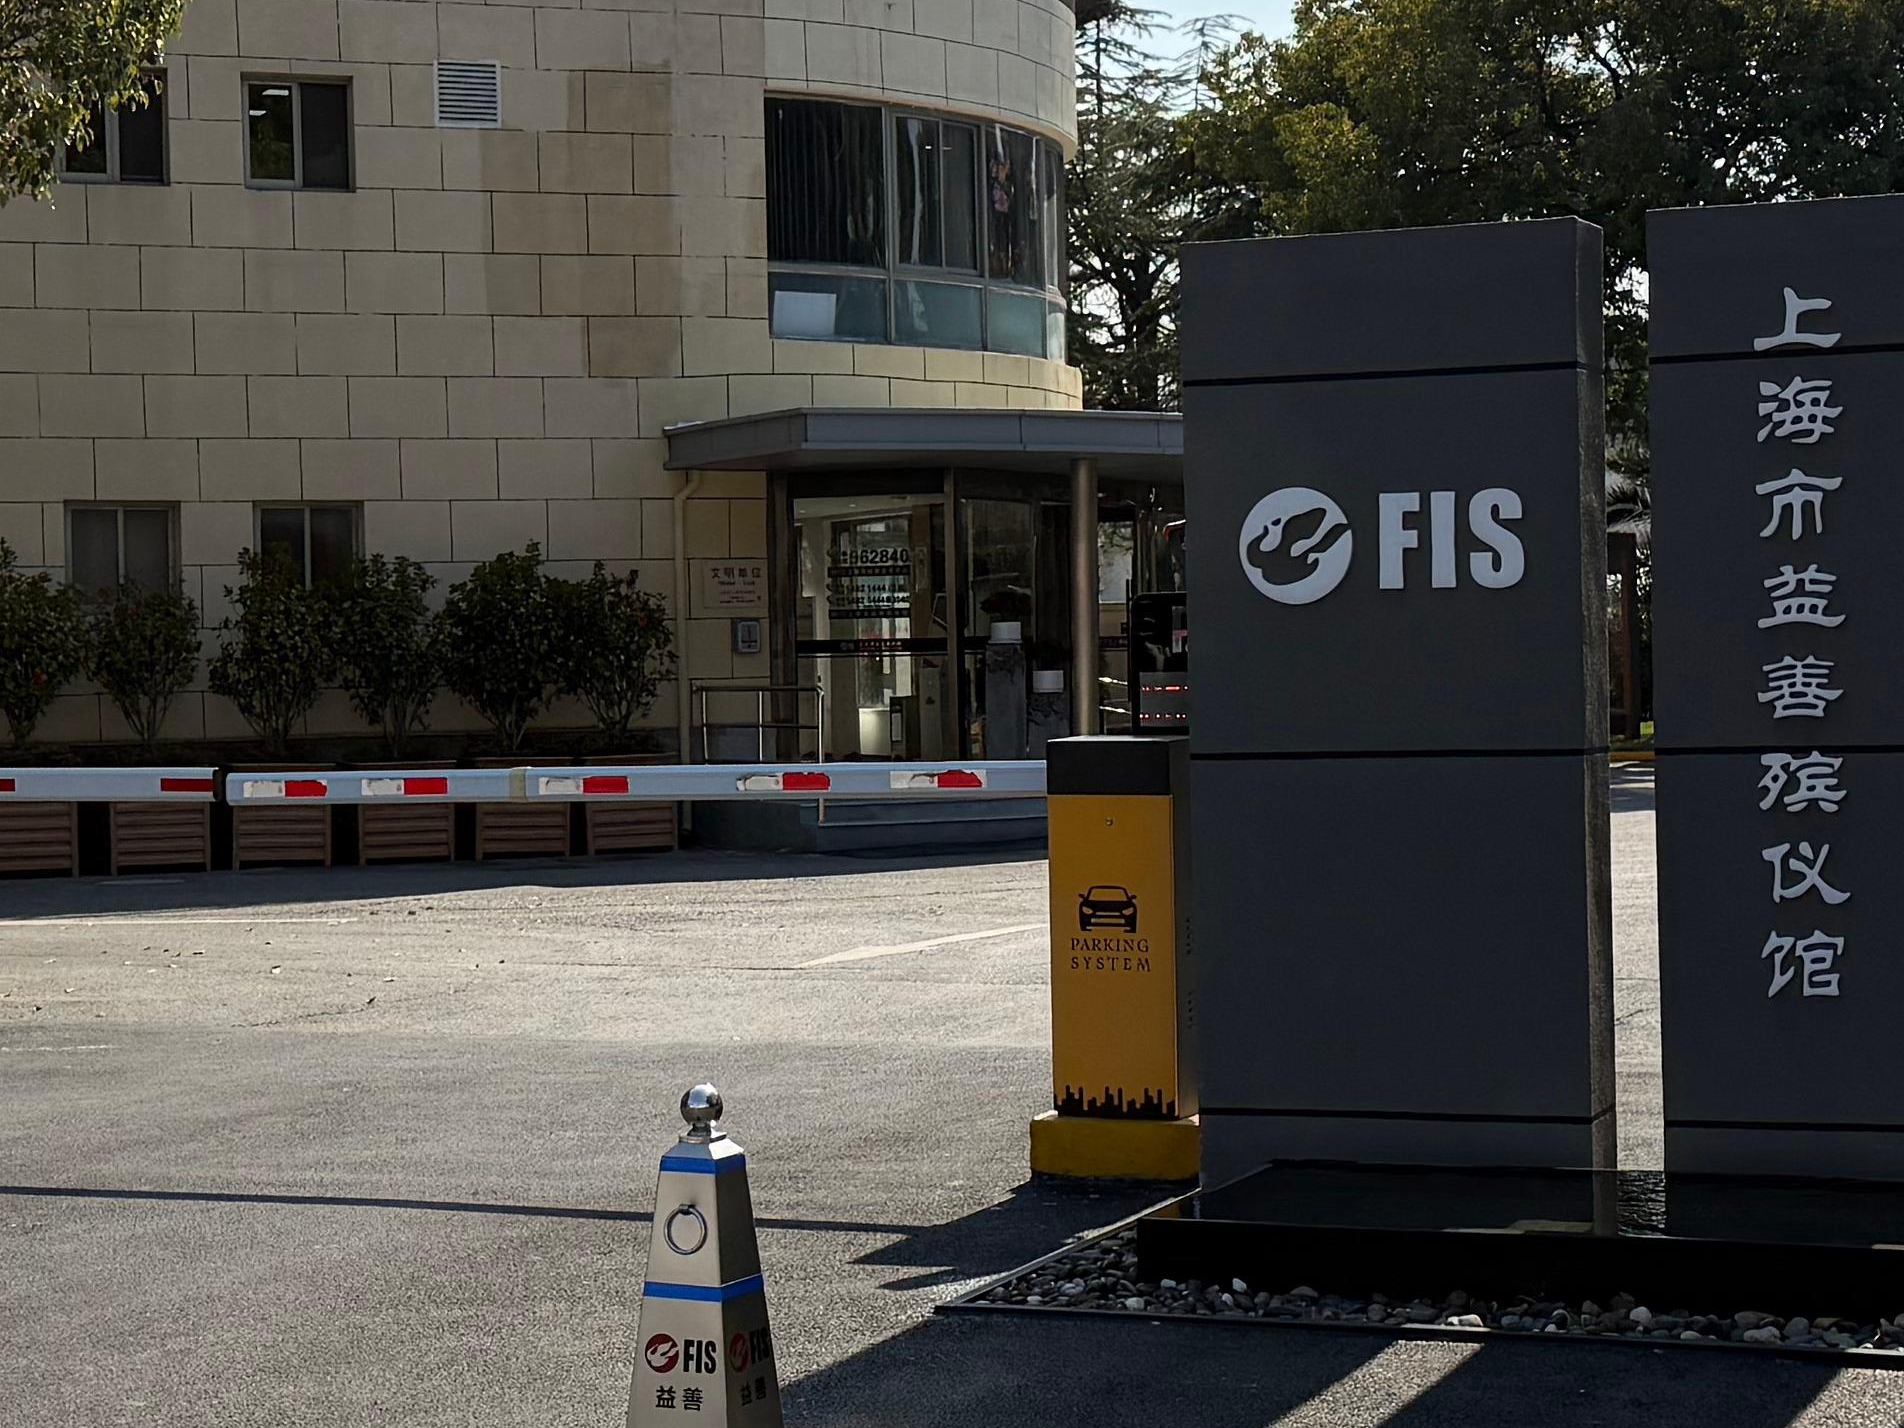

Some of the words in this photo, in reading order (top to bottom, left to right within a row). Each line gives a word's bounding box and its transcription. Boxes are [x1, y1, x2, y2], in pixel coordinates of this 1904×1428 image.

[1378, 487, 1525, 590] FIS
[1753, 286, 1851, 998] 上海市益善殡仪馆
[1070, 938, 1149, 953] PARKING
[1070, 956, 1151, 972] SYSTEM
[683, 1339, 717, 1374] FIS
[655, 1385, 704, 1412] 益善
